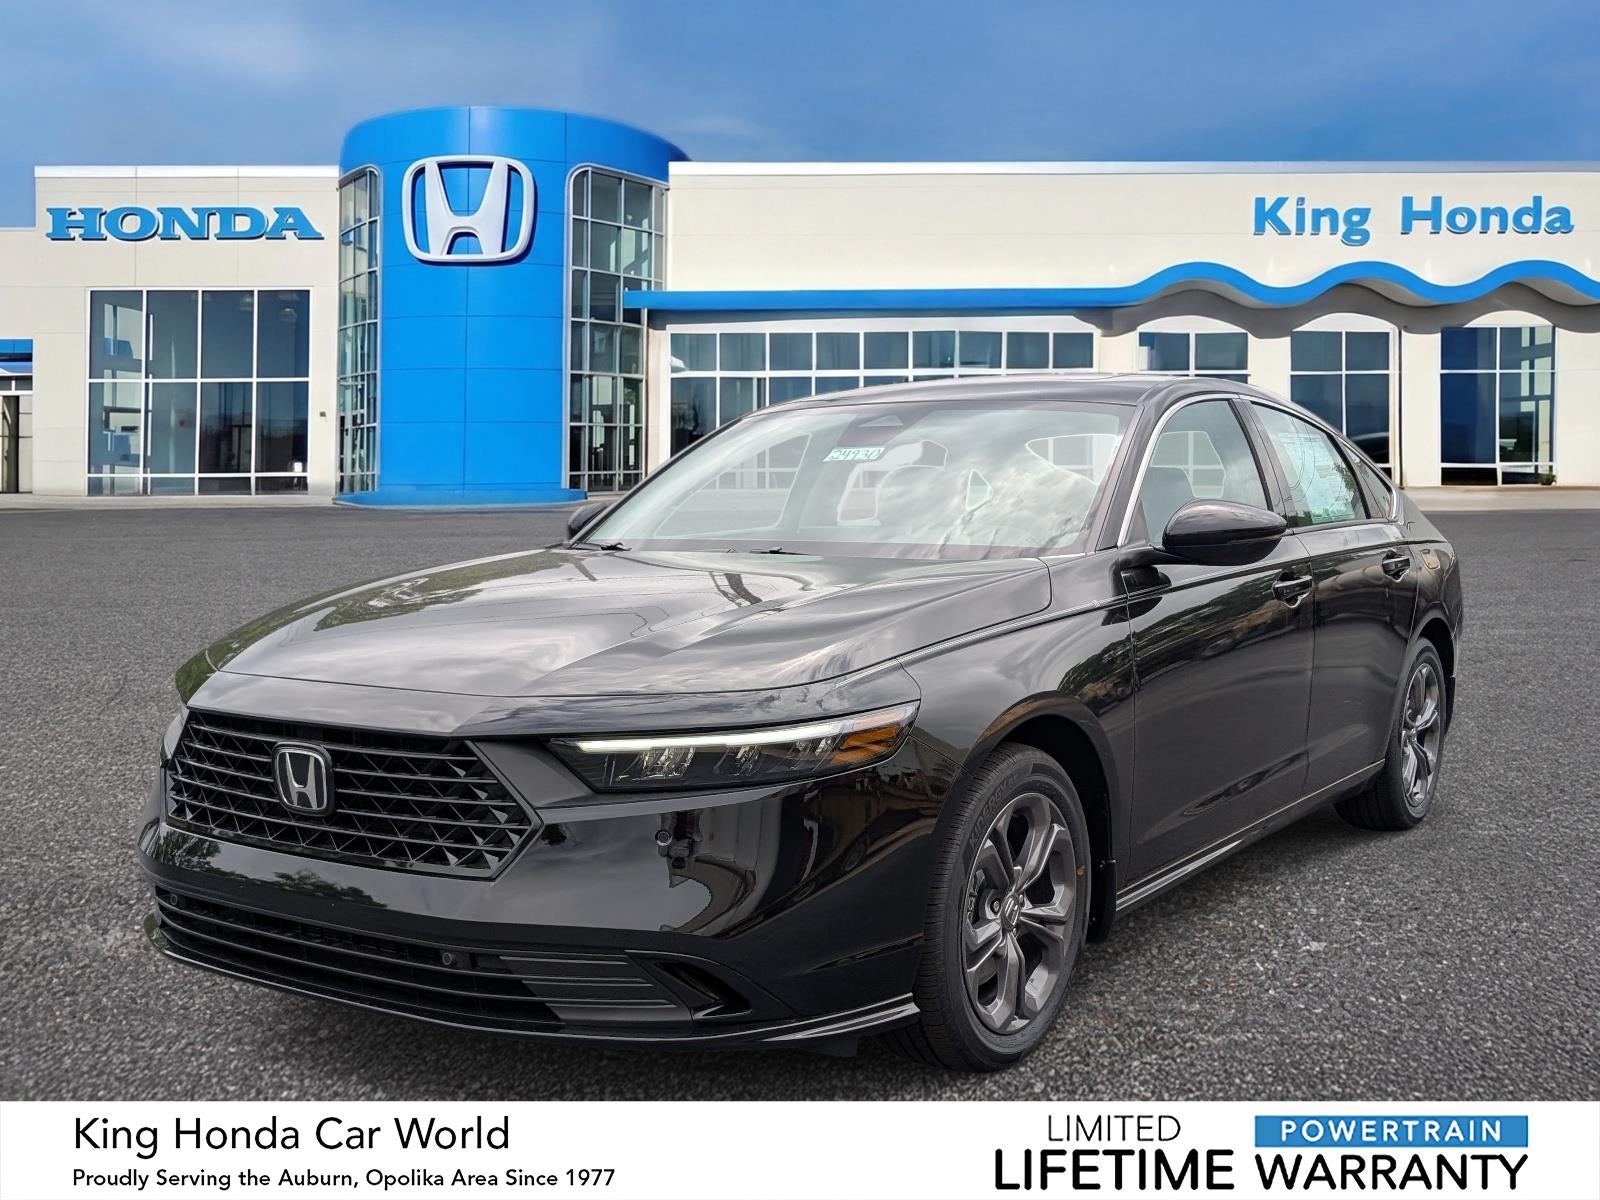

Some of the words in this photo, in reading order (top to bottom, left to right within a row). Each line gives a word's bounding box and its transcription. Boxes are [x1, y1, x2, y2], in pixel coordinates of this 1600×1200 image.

[46, 206, 324, 242] HONDA
[1253, 196, 1372, 246] King
[1400, 195, 1575, 235] Honda
